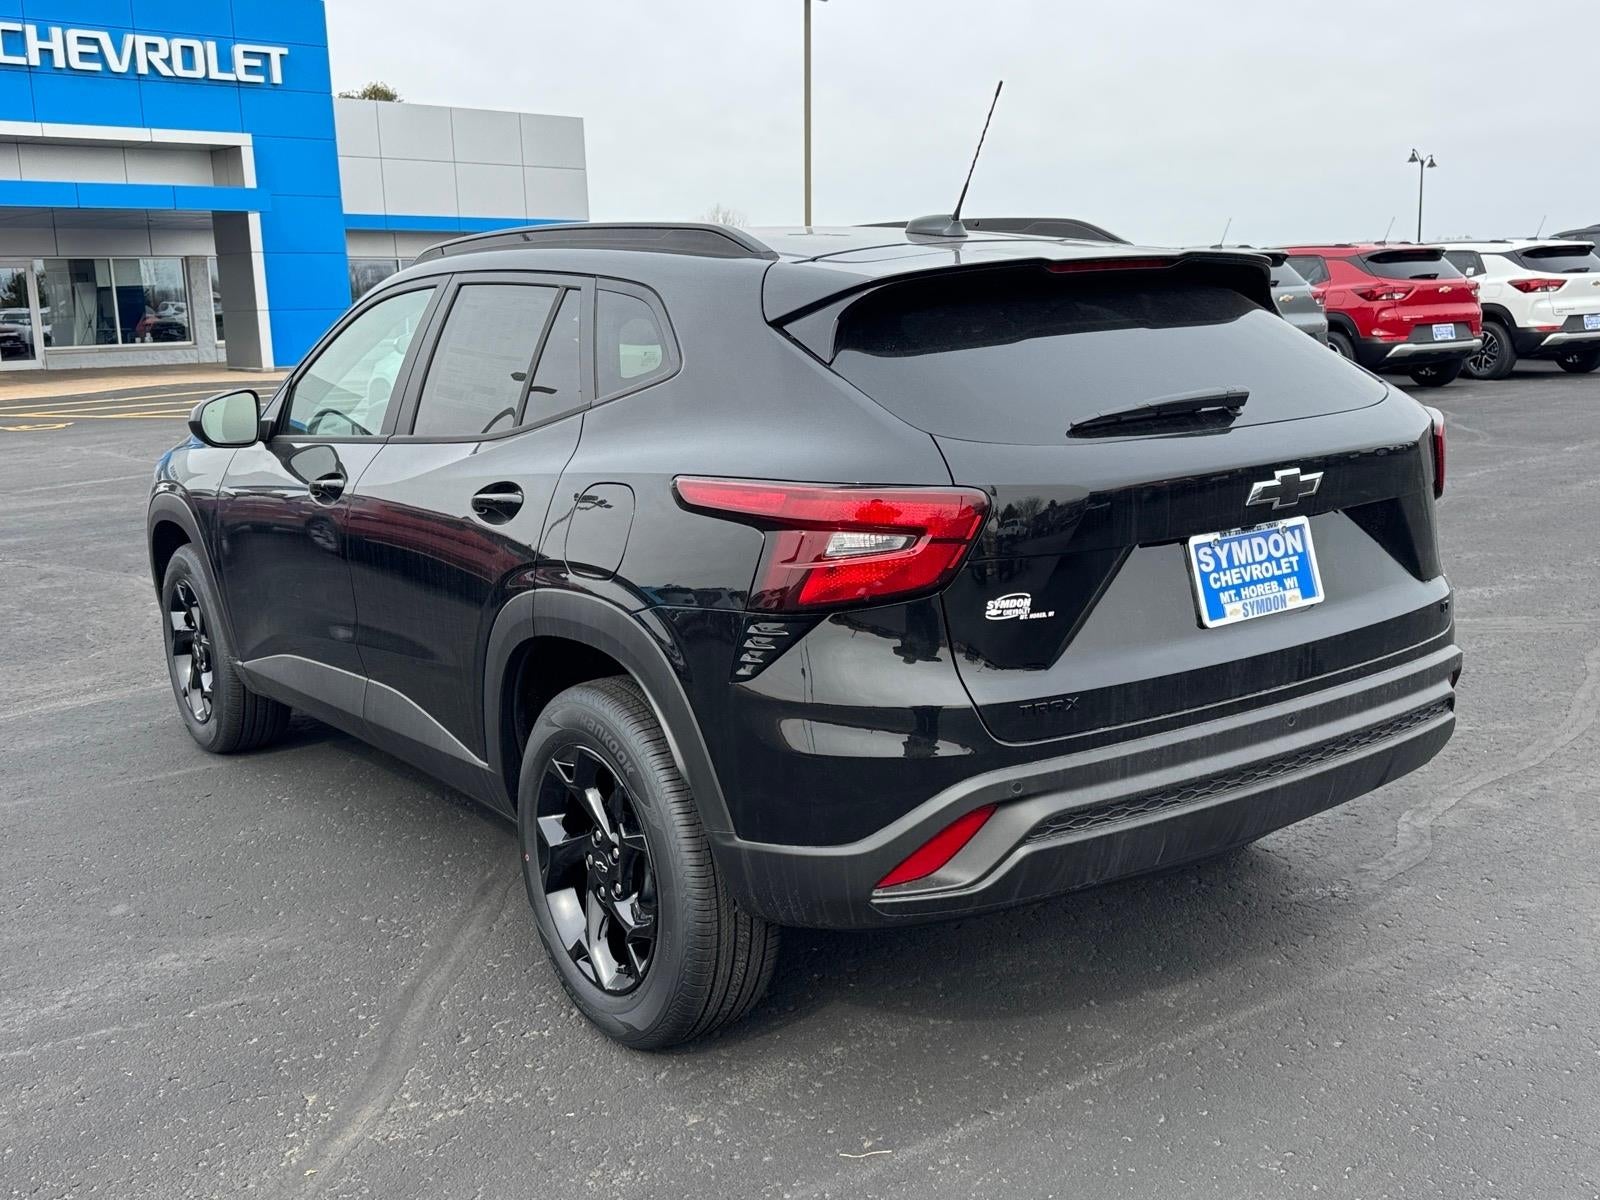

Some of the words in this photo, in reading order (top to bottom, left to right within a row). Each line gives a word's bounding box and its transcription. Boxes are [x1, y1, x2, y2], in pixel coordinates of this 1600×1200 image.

[0, 22, 289, 84] CHEVROLET
[1197, 531, 1304, 573] SYMDON
[1209, 556, 1300, 589] CHEVROLET
[986, 597, 1032, 610] SYMDON
[1219, 590, 1239, 605] MT.
[1240, 580, 1283, 601] HOREB,
[1283, 576, 1299, 590] WI
[1242, 594, 1288, 618] SYMDON
